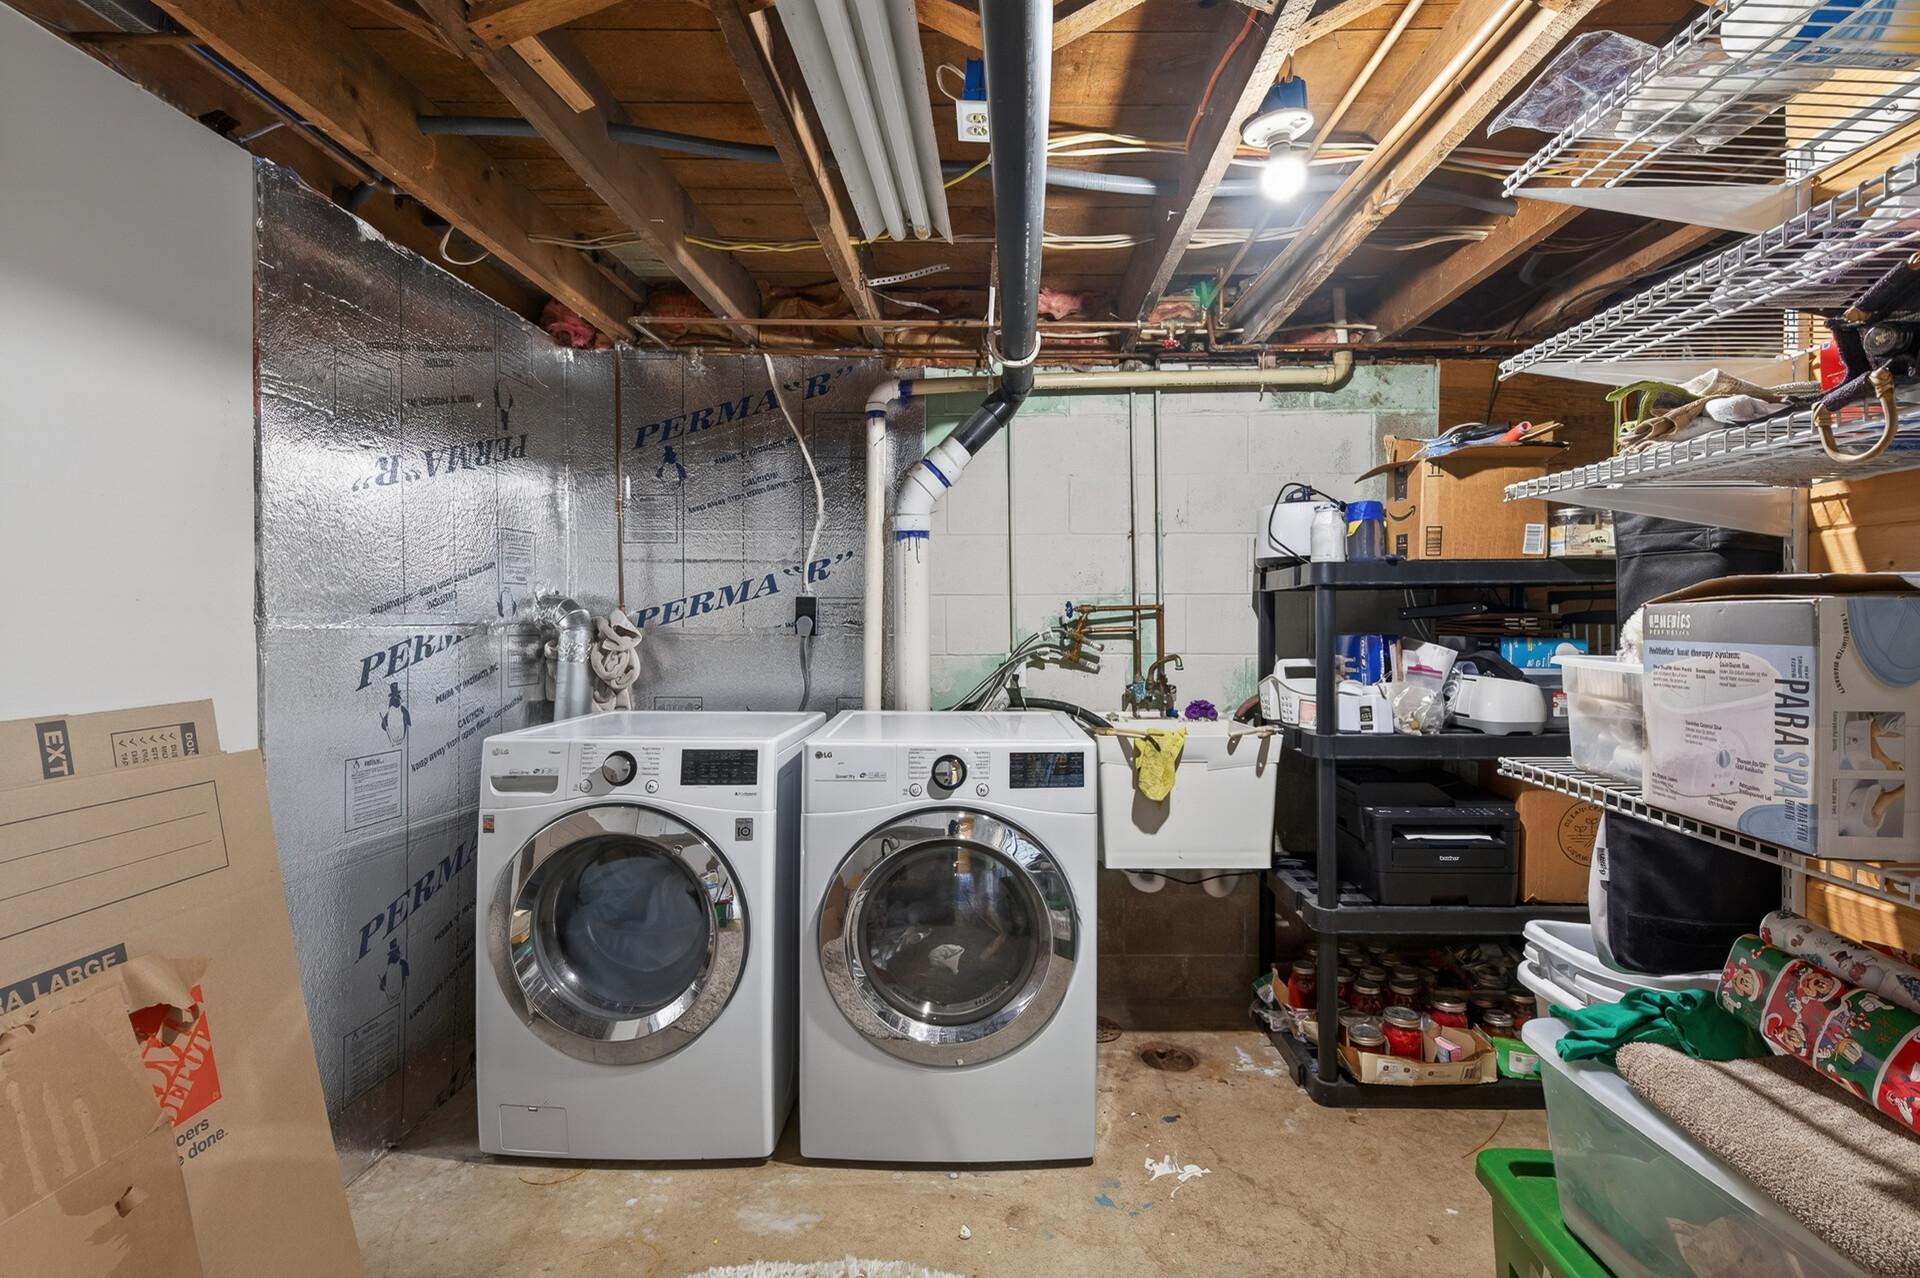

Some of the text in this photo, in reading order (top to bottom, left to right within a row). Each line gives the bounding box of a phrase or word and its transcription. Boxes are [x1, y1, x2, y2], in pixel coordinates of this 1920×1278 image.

[355, 634, 471, 691] PER
[44, 730, 70, 776] EXT
[31, 951, 118, 997] LARGE
